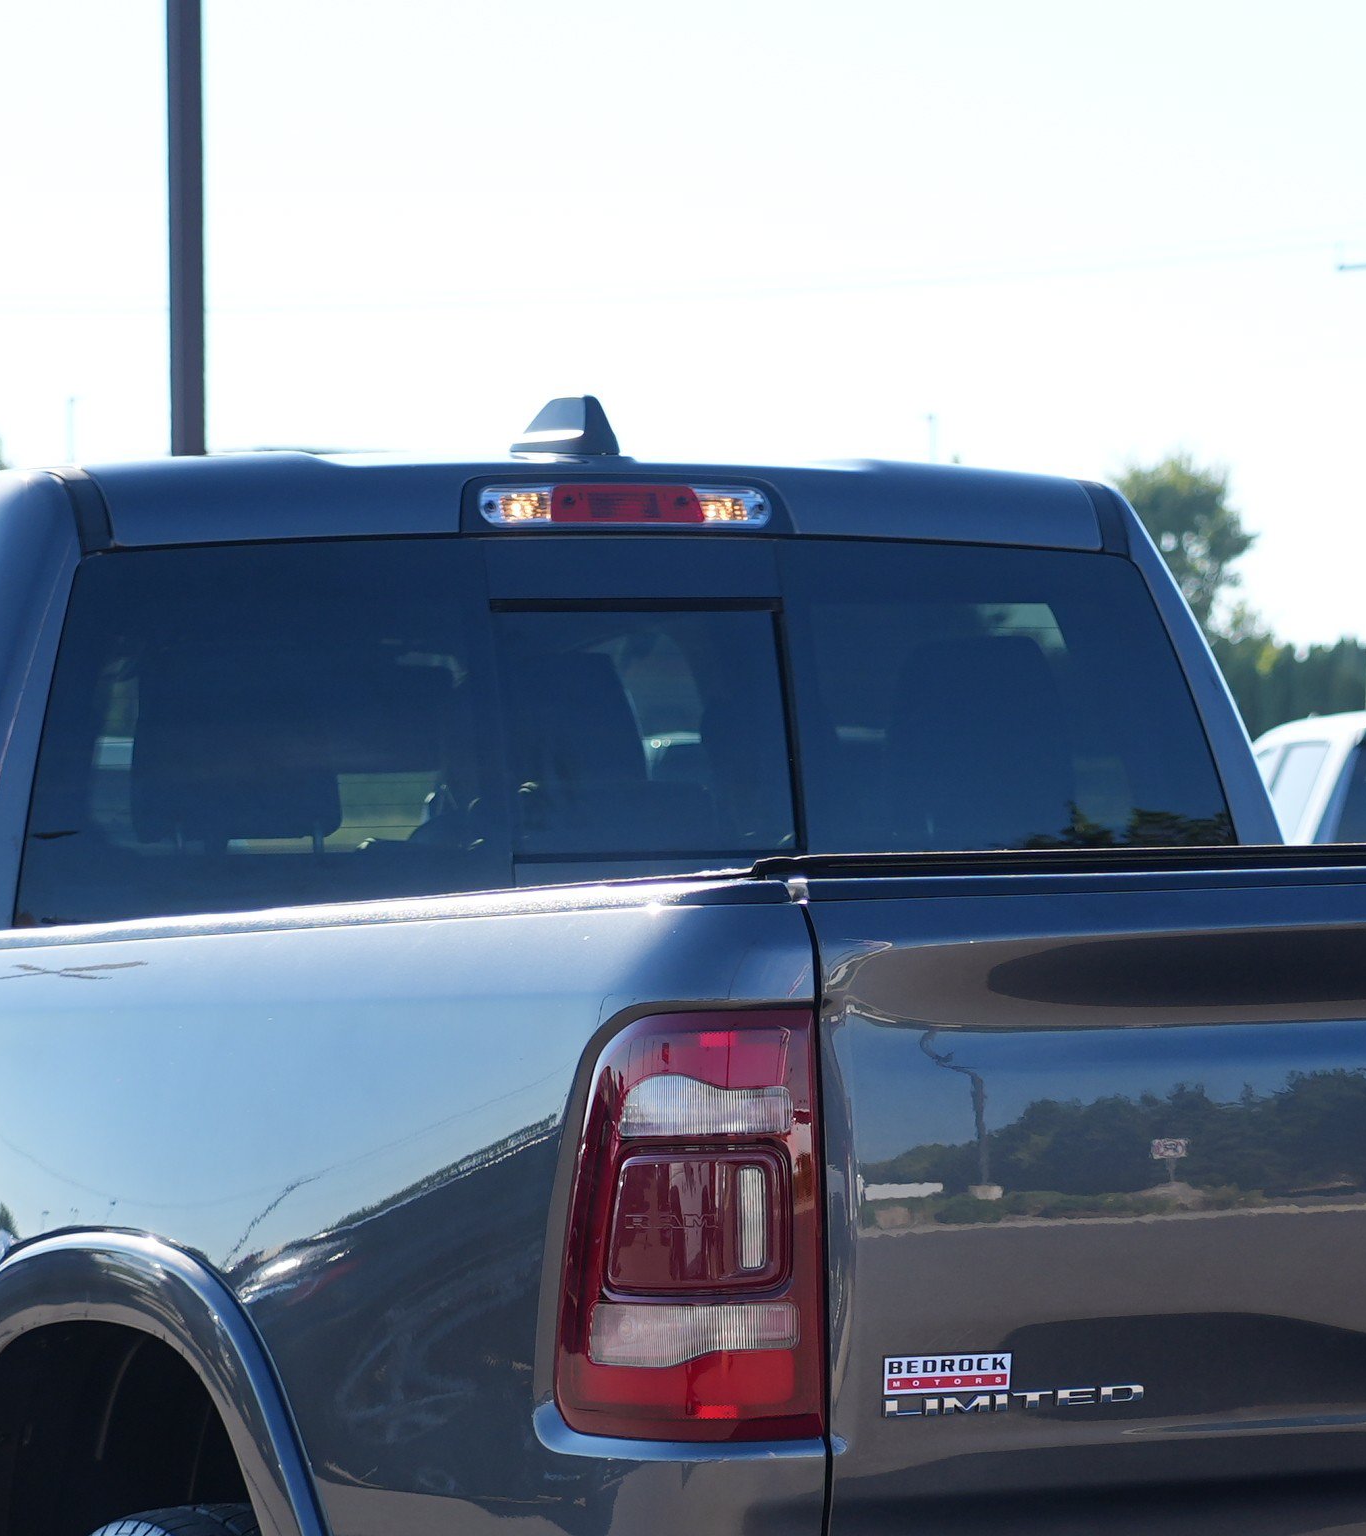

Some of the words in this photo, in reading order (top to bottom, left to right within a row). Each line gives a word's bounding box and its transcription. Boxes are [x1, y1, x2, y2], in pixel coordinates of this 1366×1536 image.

[625, 1213, 719, 1229] RAM
[887, 1356, 1007, 1375] BEDROCK
[892, 1376, 1002, 1387] MOTORS
[884, 1384, 1144, 1417] LIMITED
